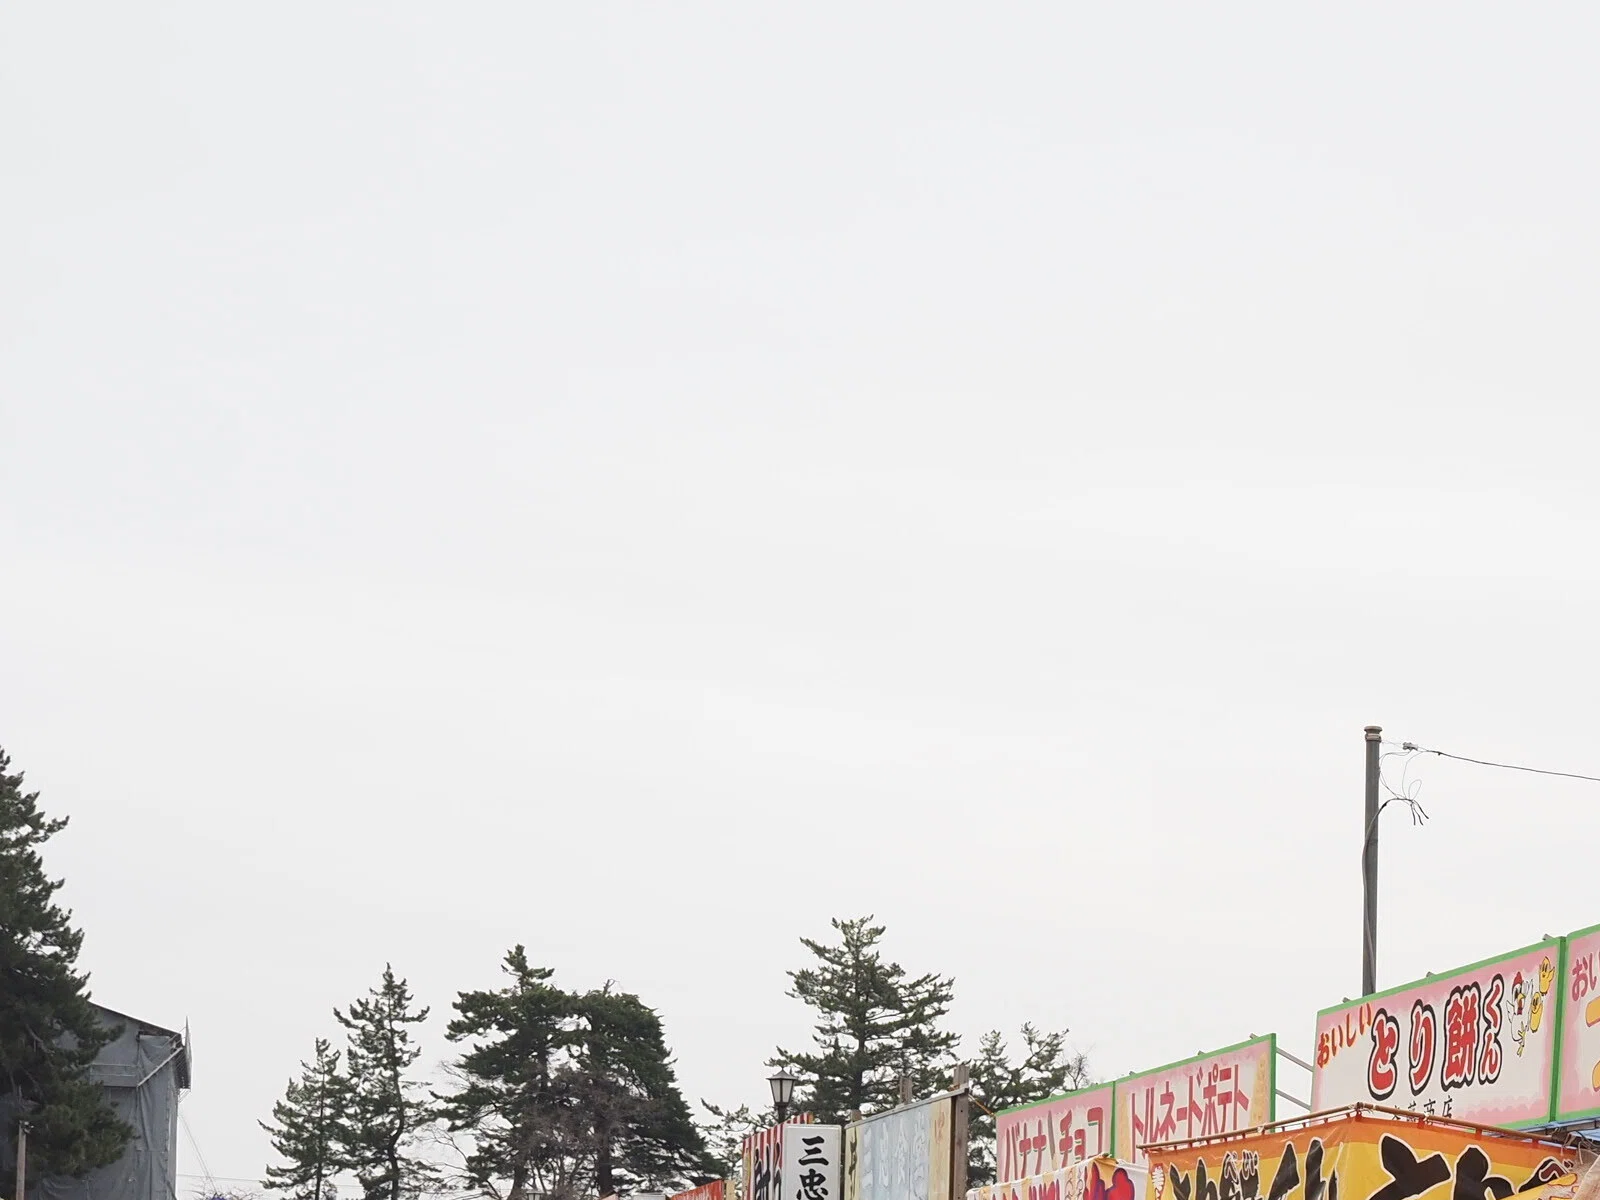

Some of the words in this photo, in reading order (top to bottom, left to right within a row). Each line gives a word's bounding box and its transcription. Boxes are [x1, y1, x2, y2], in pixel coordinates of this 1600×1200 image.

[1317, 1002, 1374, 1068] おいしい
[1368, 973, 1504, 1101] とり餅くん
[1132, 1063, 1250, 1162] トルネードポテト
